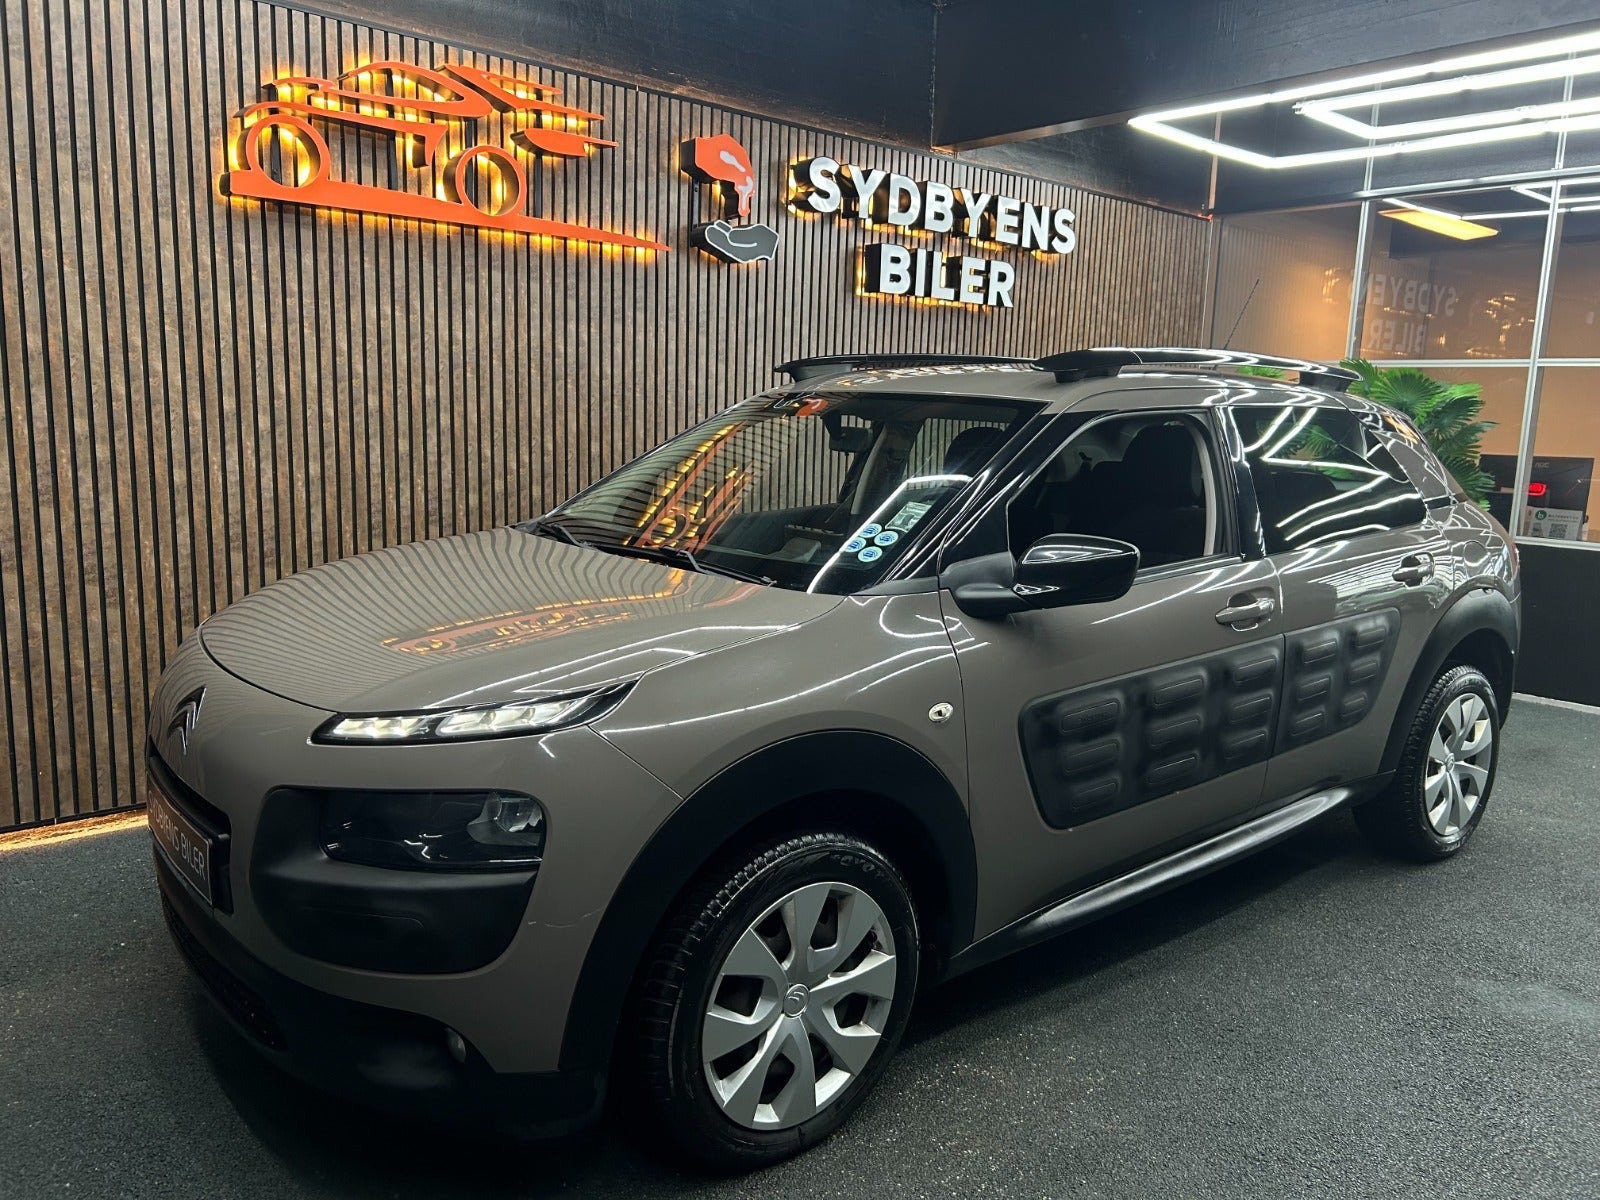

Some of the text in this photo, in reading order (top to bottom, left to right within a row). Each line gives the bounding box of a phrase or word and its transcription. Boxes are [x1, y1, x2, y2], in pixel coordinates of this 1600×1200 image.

[808, 156, 1077, 255] SYDBYENS
[879, 243, 1015, 308] BILER
[180, 831, 206, 881] BILER
